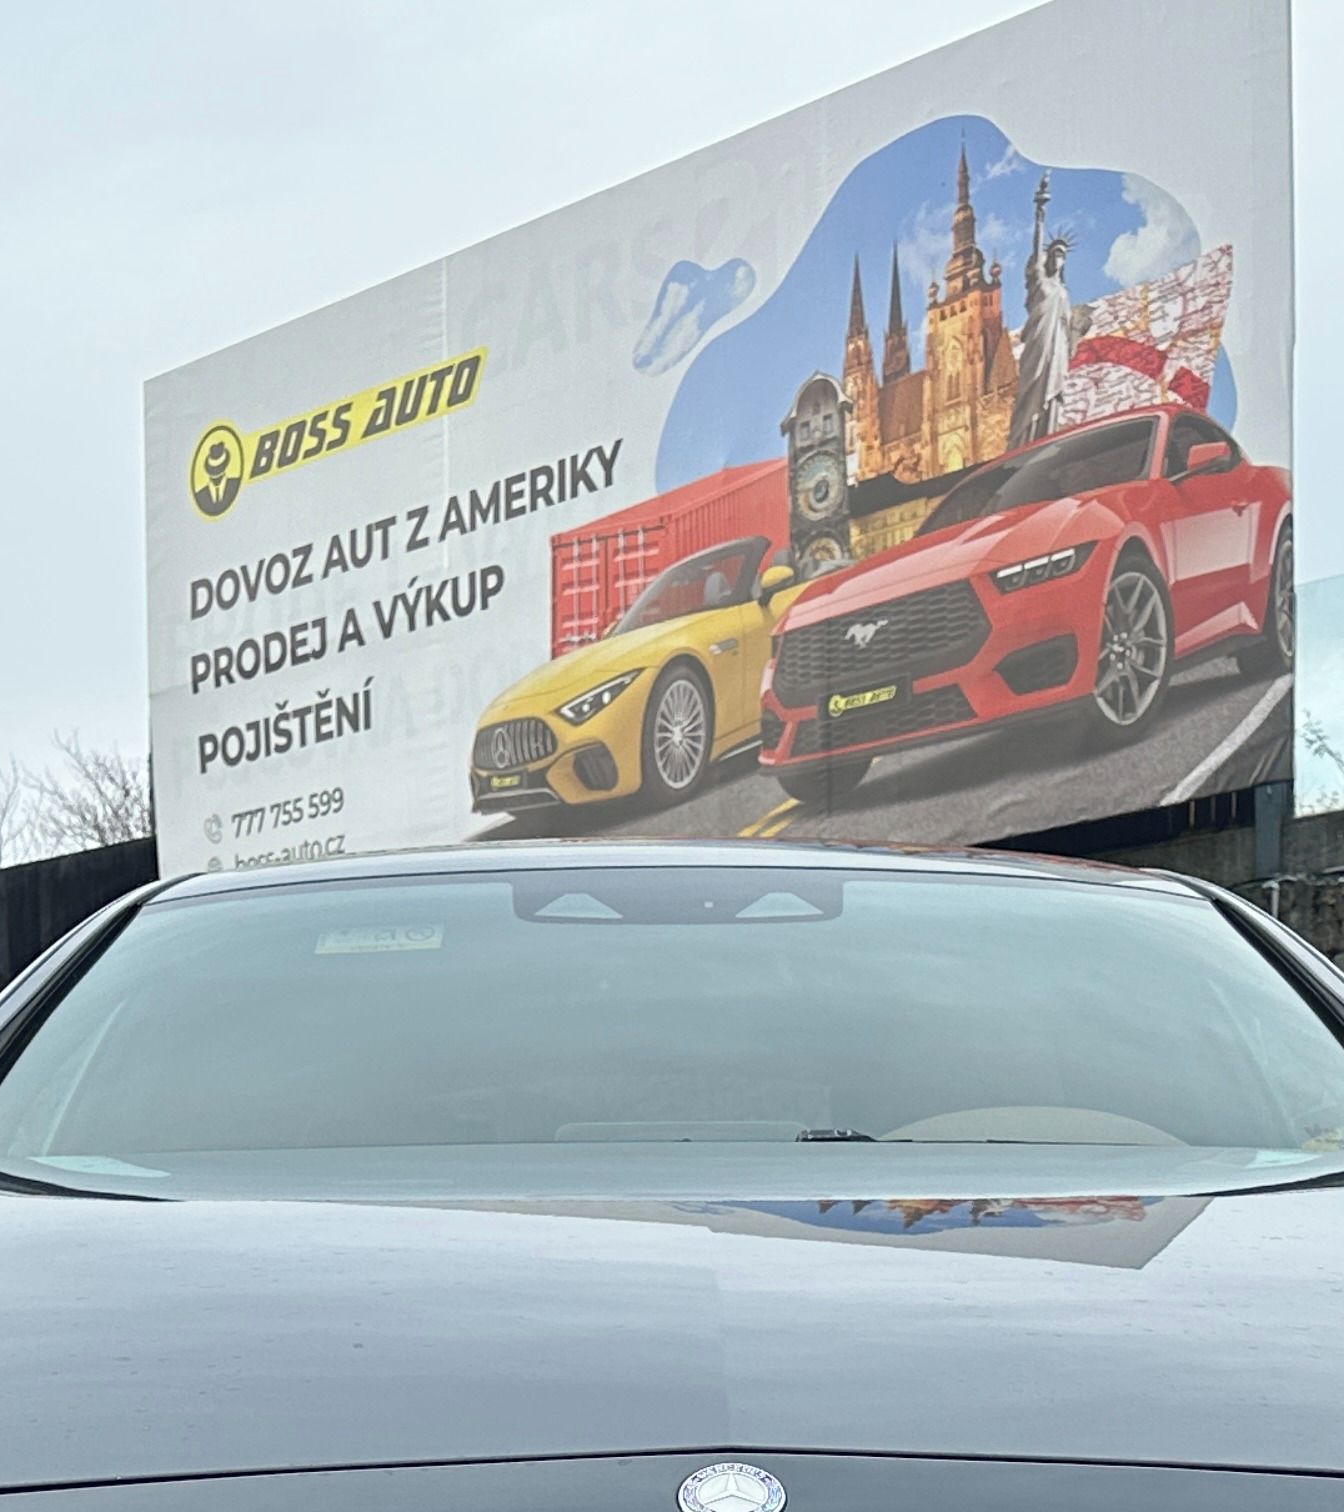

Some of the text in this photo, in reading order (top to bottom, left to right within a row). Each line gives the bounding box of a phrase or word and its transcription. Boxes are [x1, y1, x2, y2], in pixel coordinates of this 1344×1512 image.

[249, 354, 481, 480] BOSS AUTO
[190, 437, 624, 621] DOVOZ AUT Z AMERIKY
[190, 564, 505, 695] PRODEJ A VÝKUP
[198, 676, 375, 774] POJIŠTĚNÍ
[231, 787, 345, 839] 777 755 599
